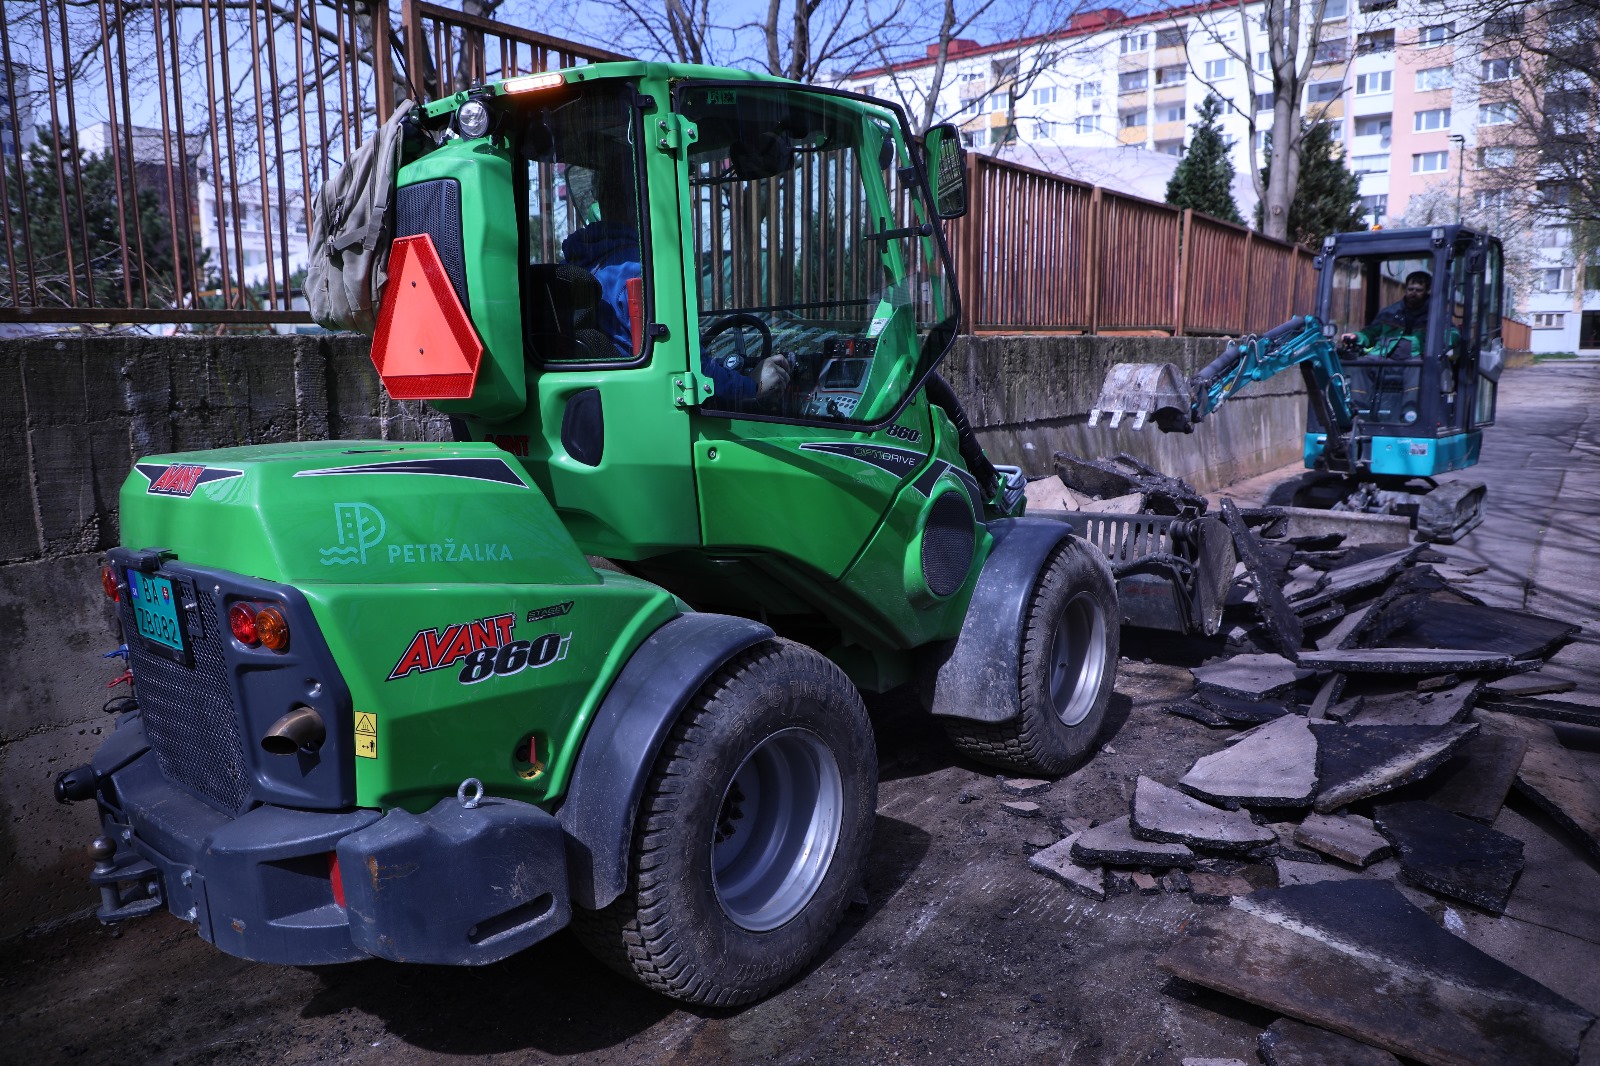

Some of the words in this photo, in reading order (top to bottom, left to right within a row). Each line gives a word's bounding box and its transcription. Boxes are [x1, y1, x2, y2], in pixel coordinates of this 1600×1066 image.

[150, 464, 206, 494] AVANT
[387, 538, 514, 564] PETRŽALKA
[142, 577, 161, 606] BA
[138, 607, 179, 645] ZB082
[528, 606, 561, 618] STAGE
[385, 612, 517, 682] AVANT
[458, 631, 573, 685] 860i
